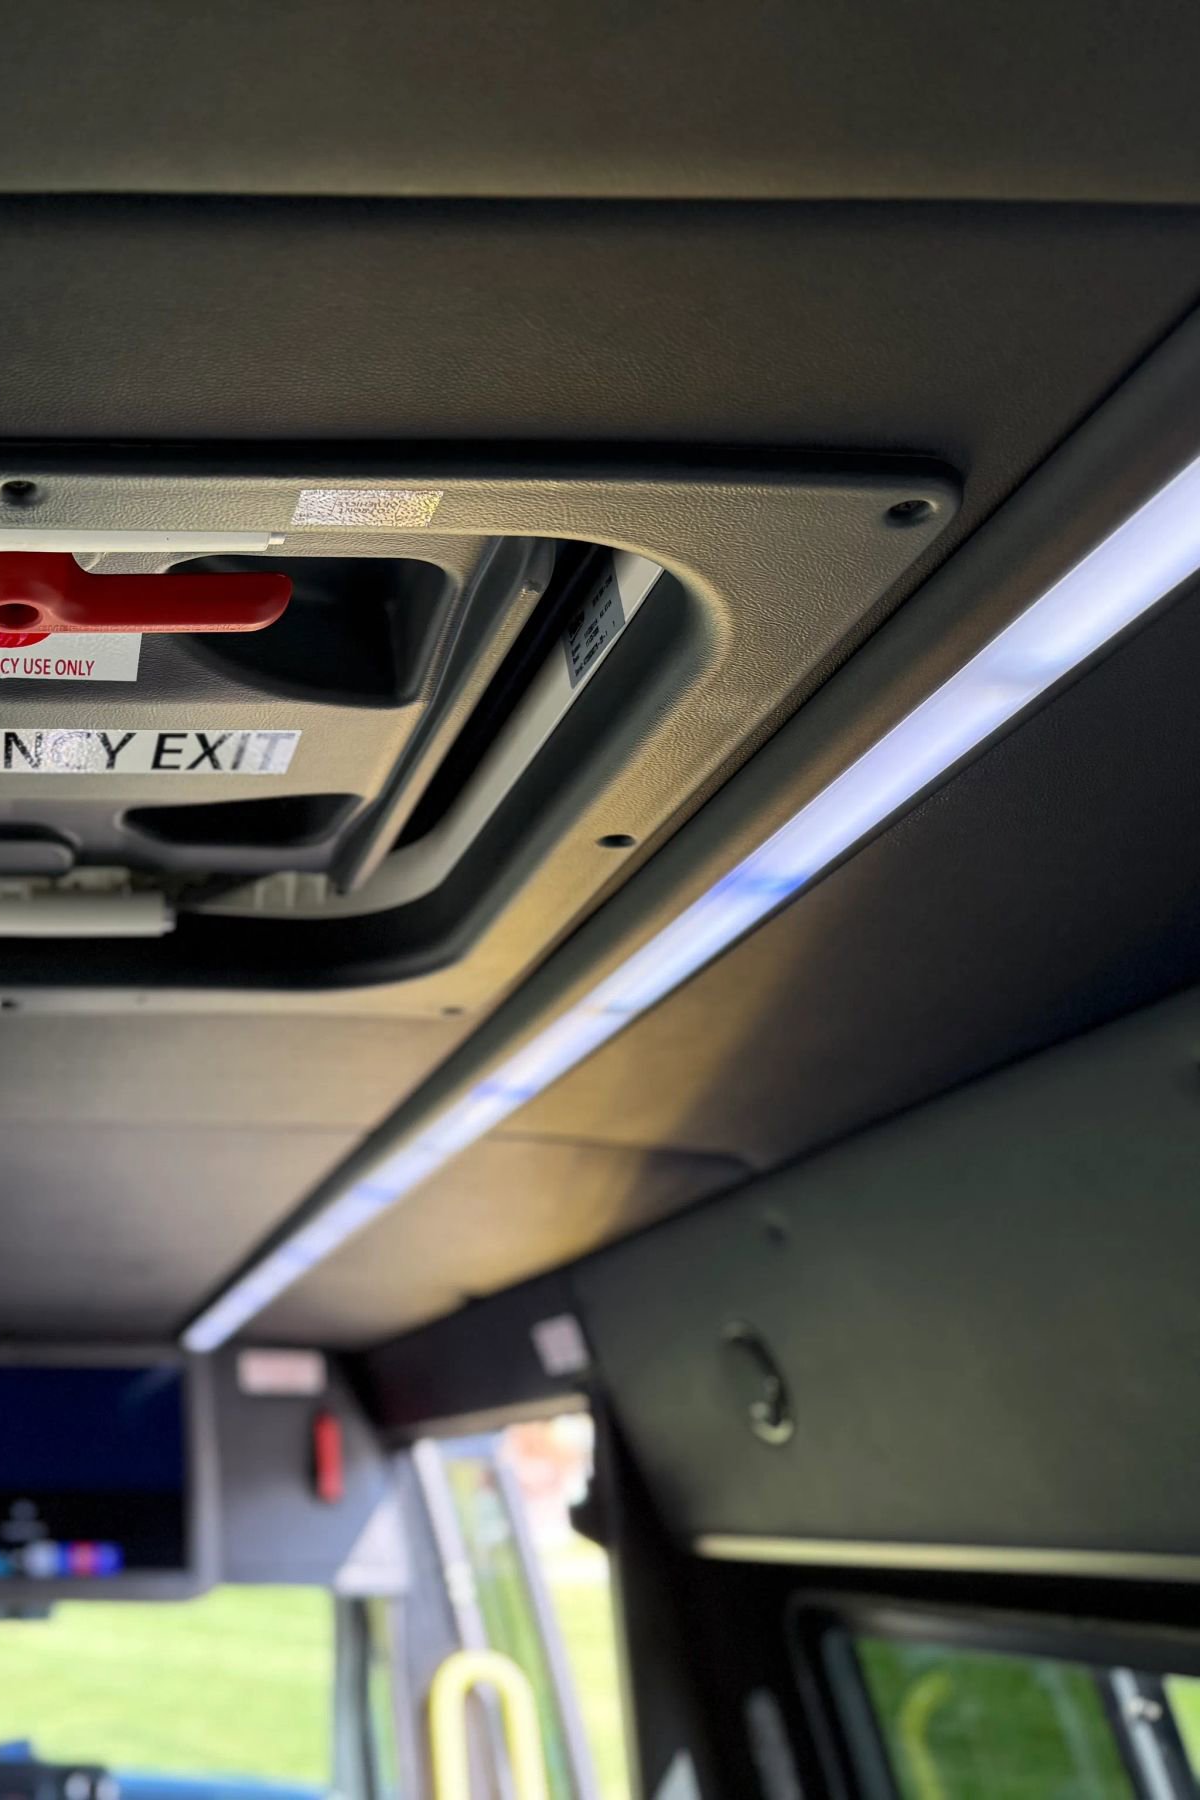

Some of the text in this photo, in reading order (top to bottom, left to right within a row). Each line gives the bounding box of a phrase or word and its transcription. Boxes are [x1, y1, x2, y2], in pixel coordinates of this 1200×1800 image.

[23, 658, 51, 675] USE
[54, 659, 95, 676] ONLY
[151, 732, 297, 771] EXIT
